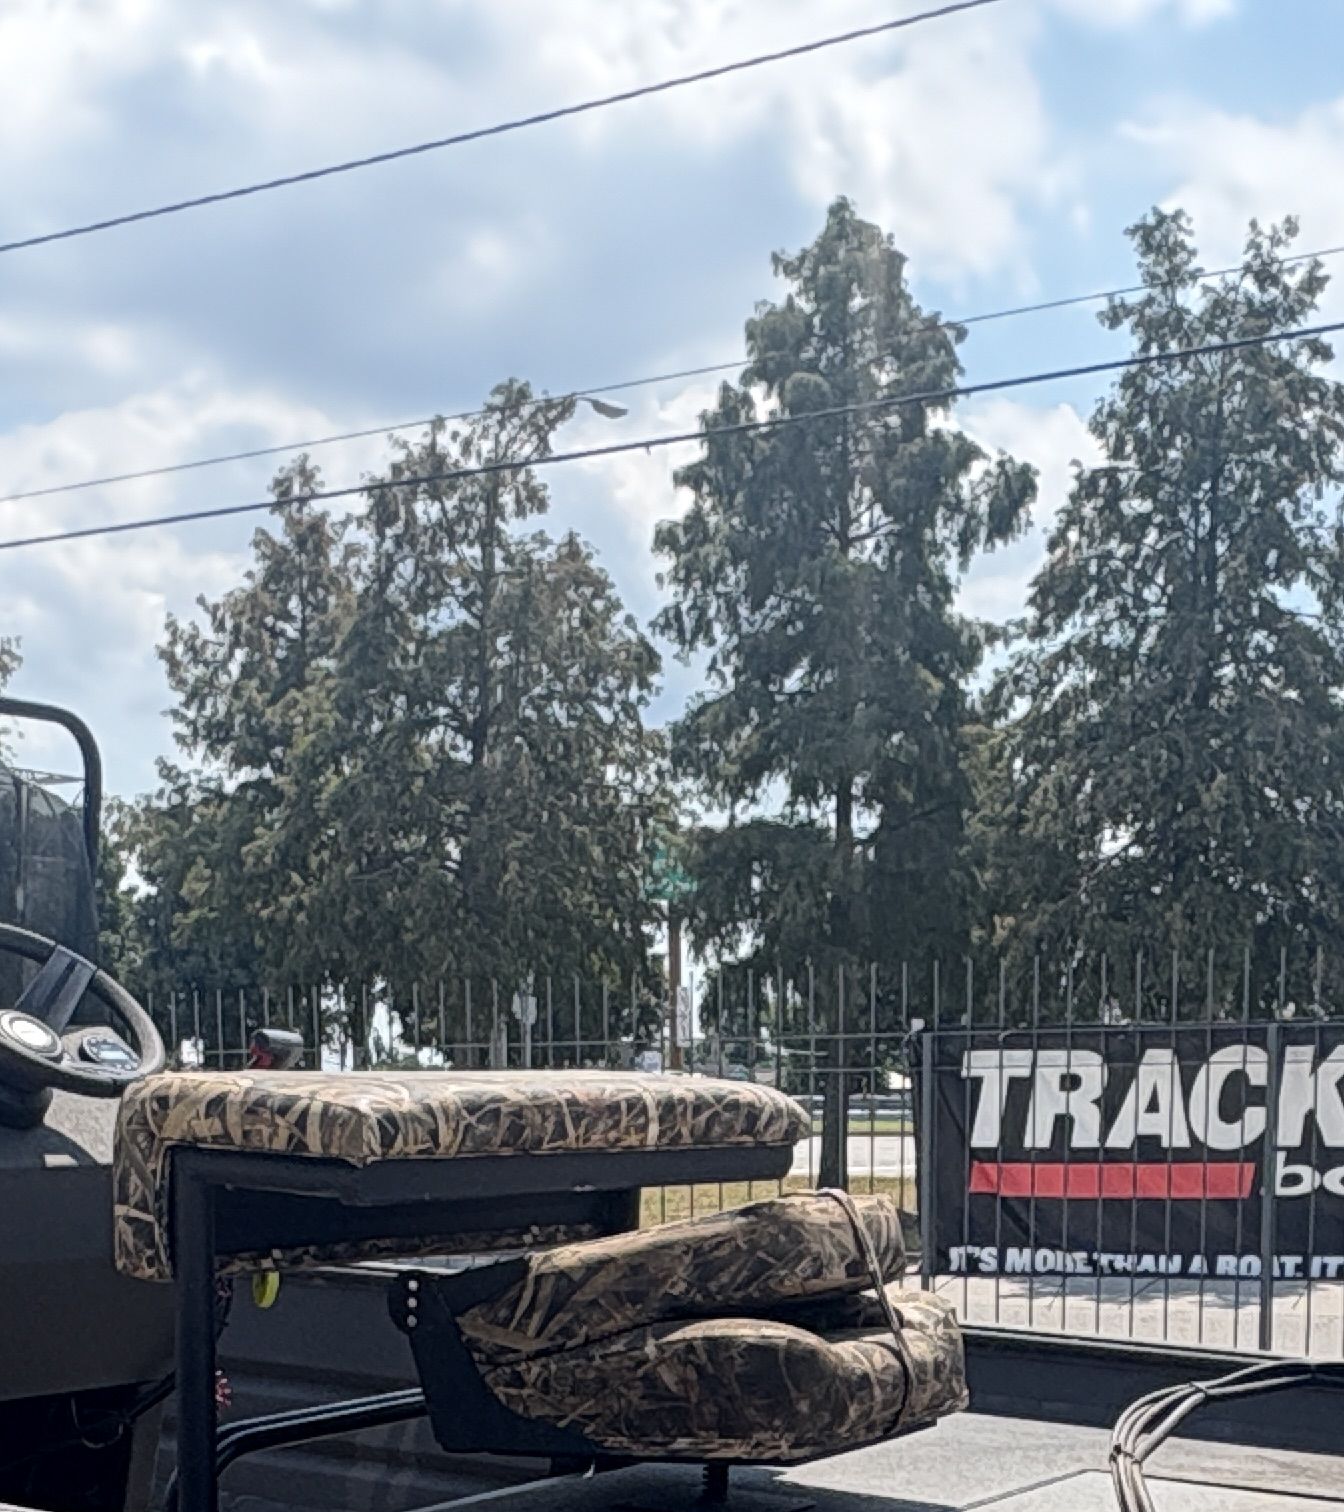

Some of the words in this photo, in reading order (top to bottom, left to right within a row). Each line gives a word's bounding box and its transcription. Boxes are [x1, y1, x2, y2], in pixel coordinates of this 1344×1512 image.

[948, 1245, 998, 1272] IT'S
[1005, 1247, 1094, 1273] MORE
[1095, 1252, 1182, 1273] THAN
[1187, 1254, 1208, 1274] A
[1217, 1254, 1304, 1278] BOT.
